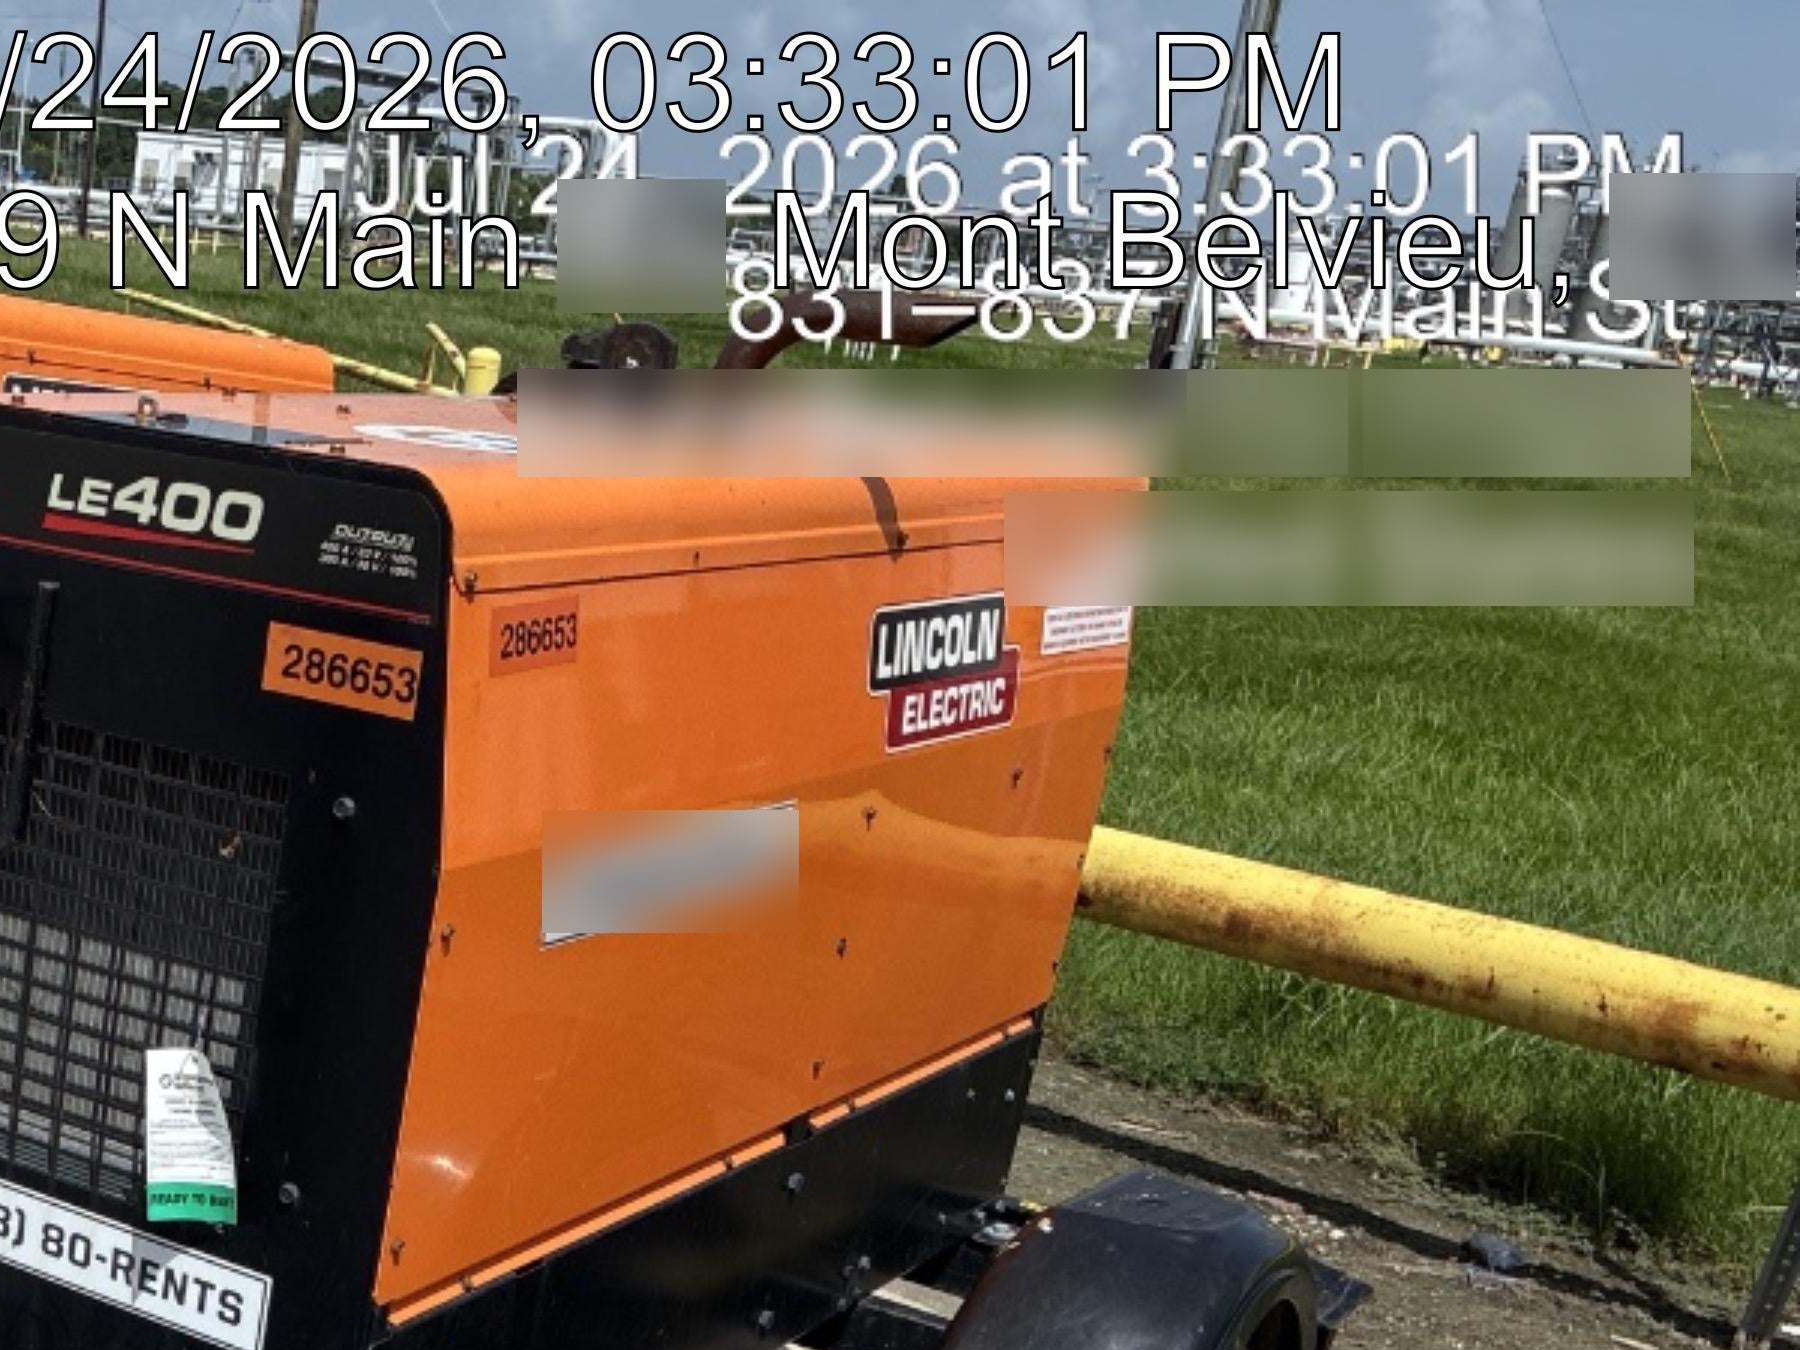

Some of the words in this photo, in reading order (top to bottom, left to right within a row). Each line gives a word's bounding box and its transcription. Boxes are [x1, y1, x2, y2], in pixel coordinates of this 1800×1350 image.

[47, 473, 265, 542] LE400
[501, 612, 577, 660] 286653
[875, 608, 1000, 680] LINCOLN
[281, 644, 418, 703] 286653
[902, 677, 1006, 736] ELECTRIC
[40, 1222, 244, 1327] 80-RENTS
